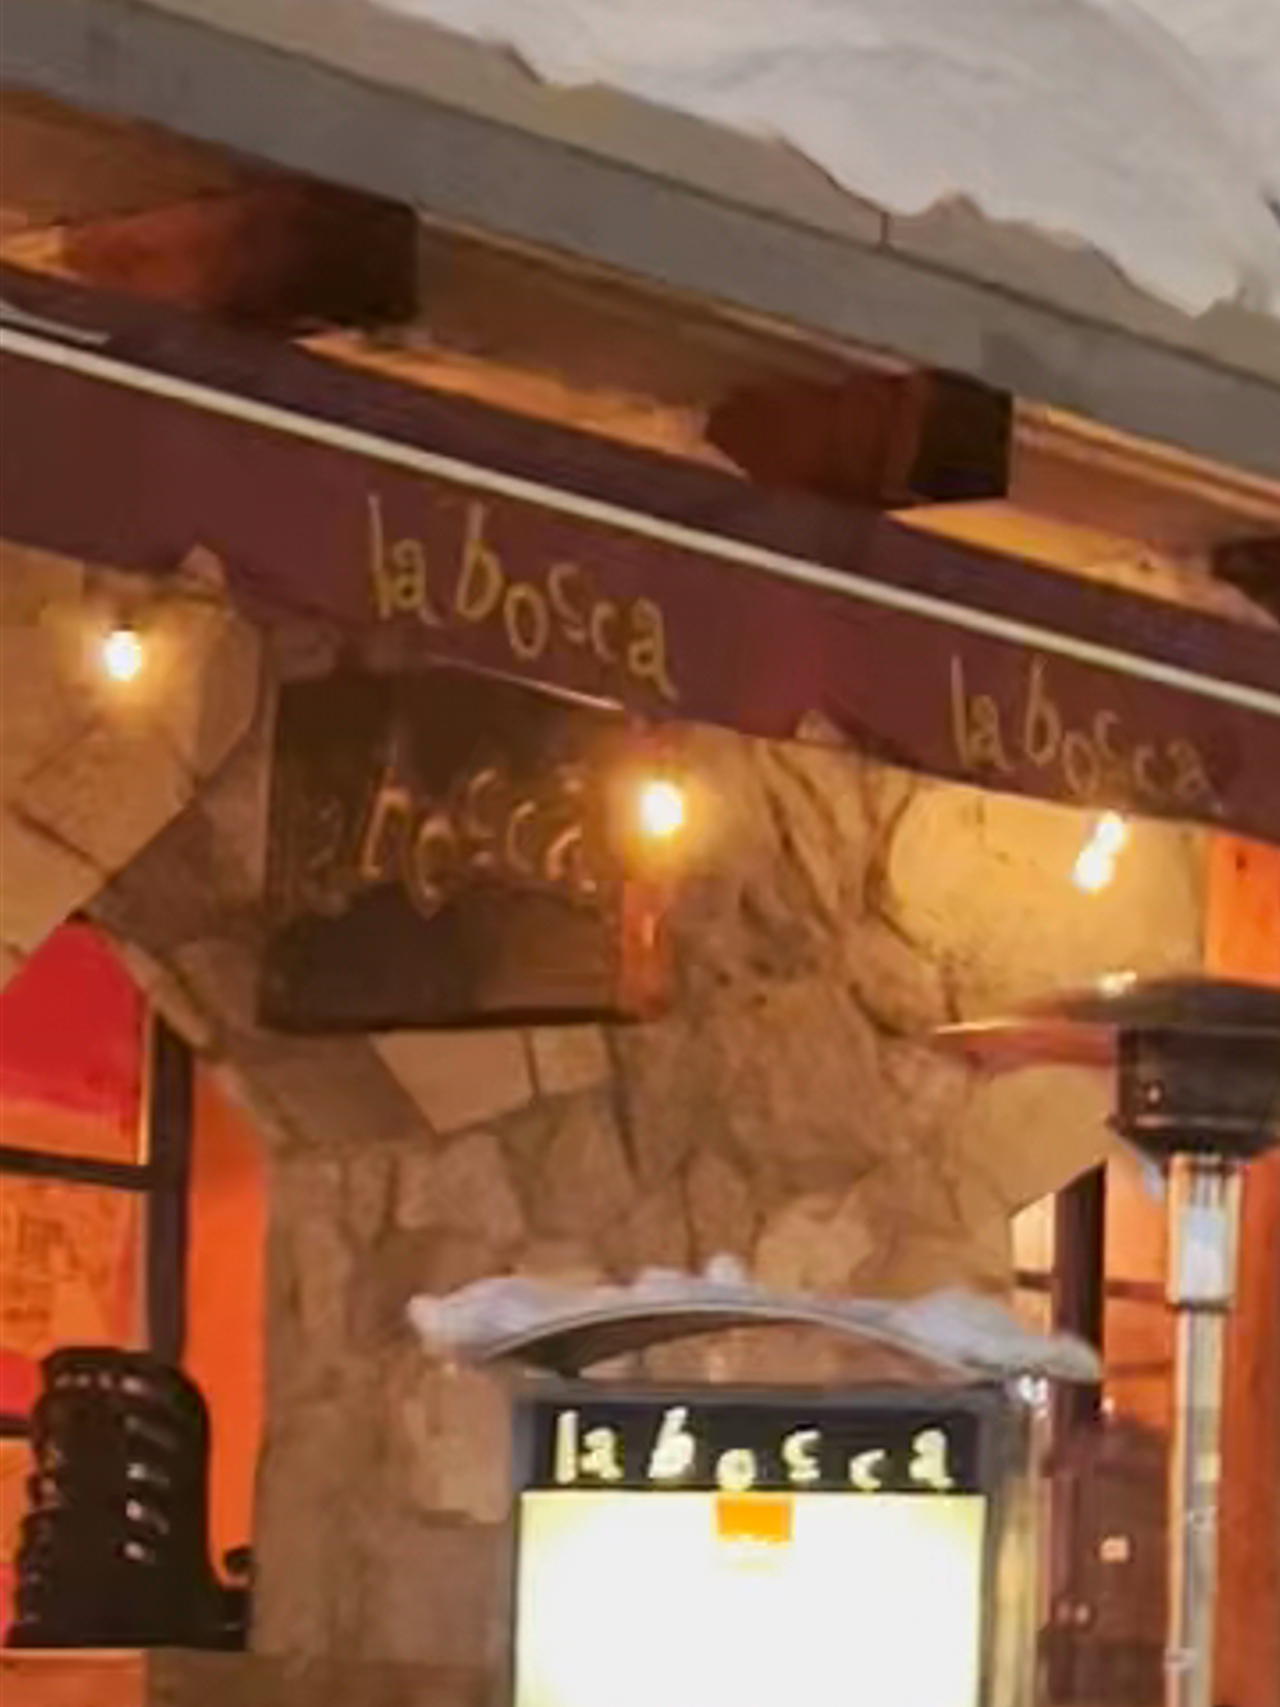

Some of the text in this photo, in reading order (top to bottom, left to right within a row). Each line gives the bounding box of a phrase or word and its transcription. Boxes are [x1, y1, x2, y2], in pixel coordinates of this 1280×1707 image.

[366, 492, 444, 629] la
[950, 654, 1016, 773] la
[555, 1408, 625, 1485] la
